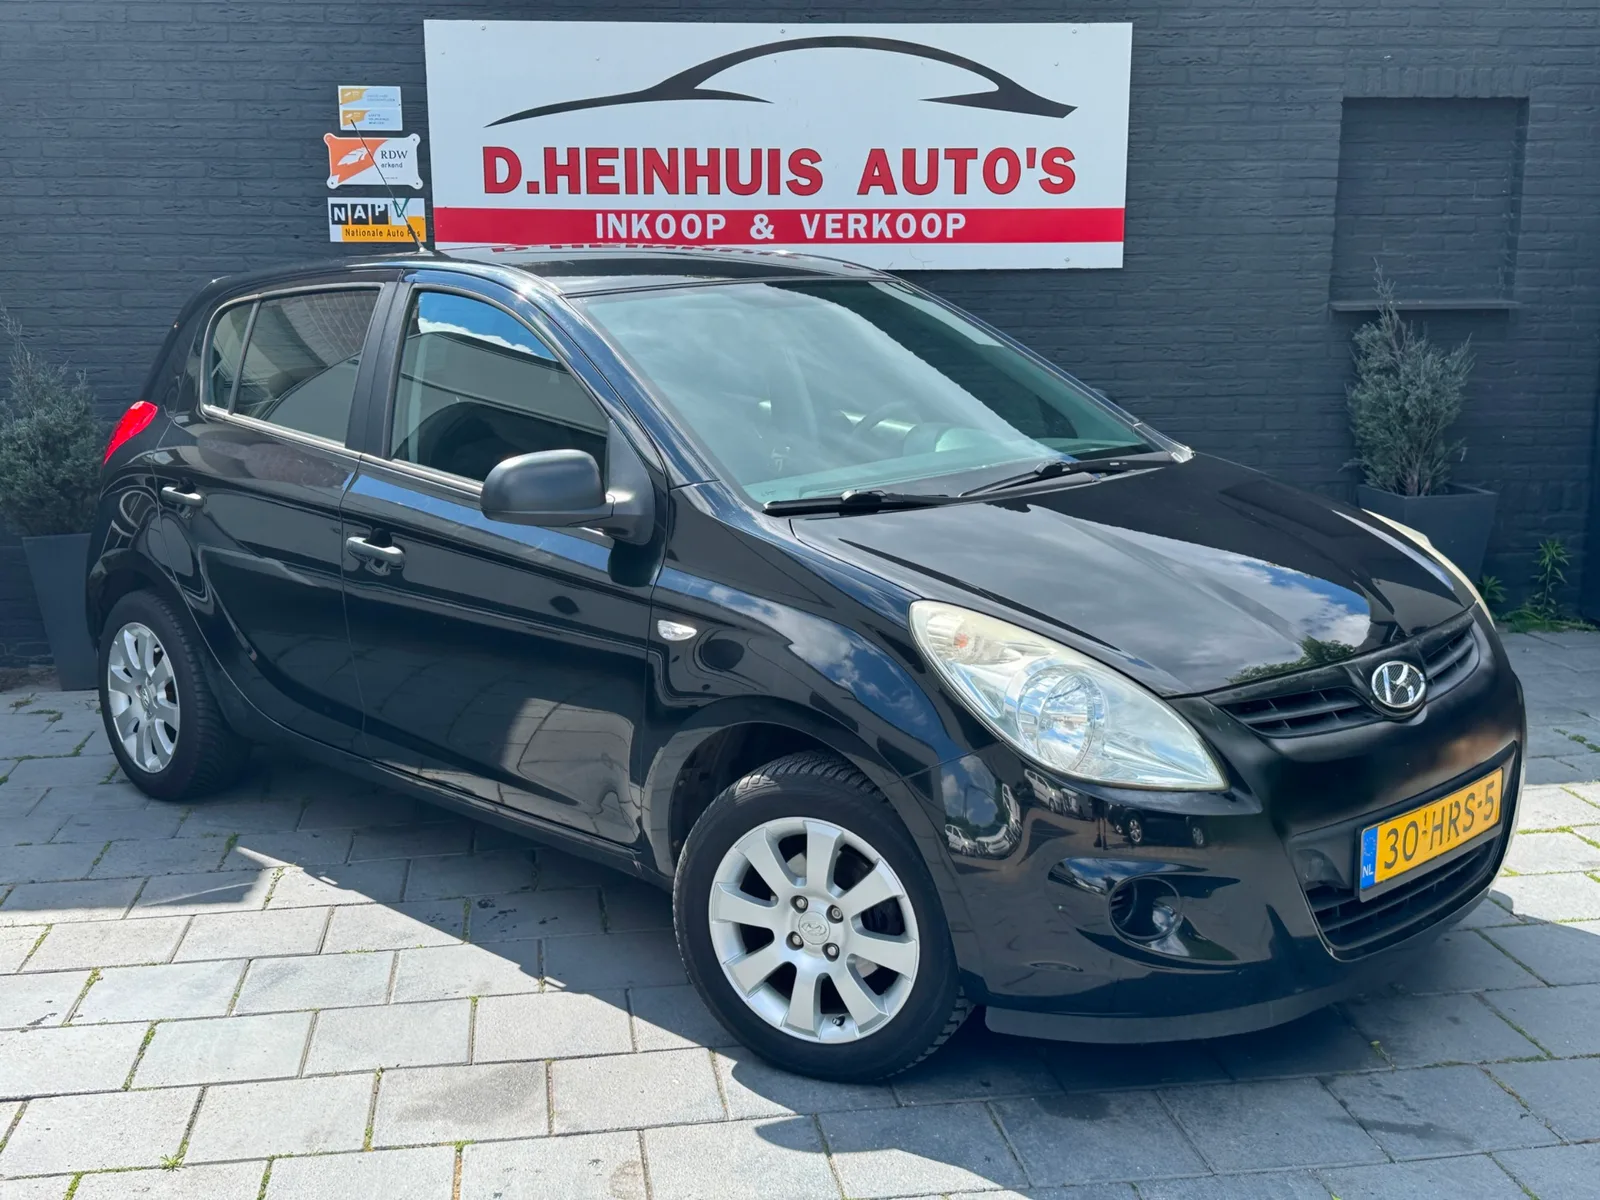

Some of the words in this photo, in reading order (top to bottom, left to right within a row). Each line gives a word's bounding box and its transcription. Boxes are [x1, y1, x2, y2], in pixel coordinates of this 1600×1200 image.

[381, 150, 408, 159] RDW
[482, 146, 823, 196] D.HEINHUIS
[856, 147, 1076, 195] AUTO'S
[333, 204, 385, 221] NAP
[345, 229, 383, 237] Nationale
[387, 229, 404, 237] Auto
[595, 213, 726, 239] INKOOP
[750, 213, 775, 240] &
[800, 213, 966, 239] VERKOOP
[1362, 865, 1374, 878] NL
